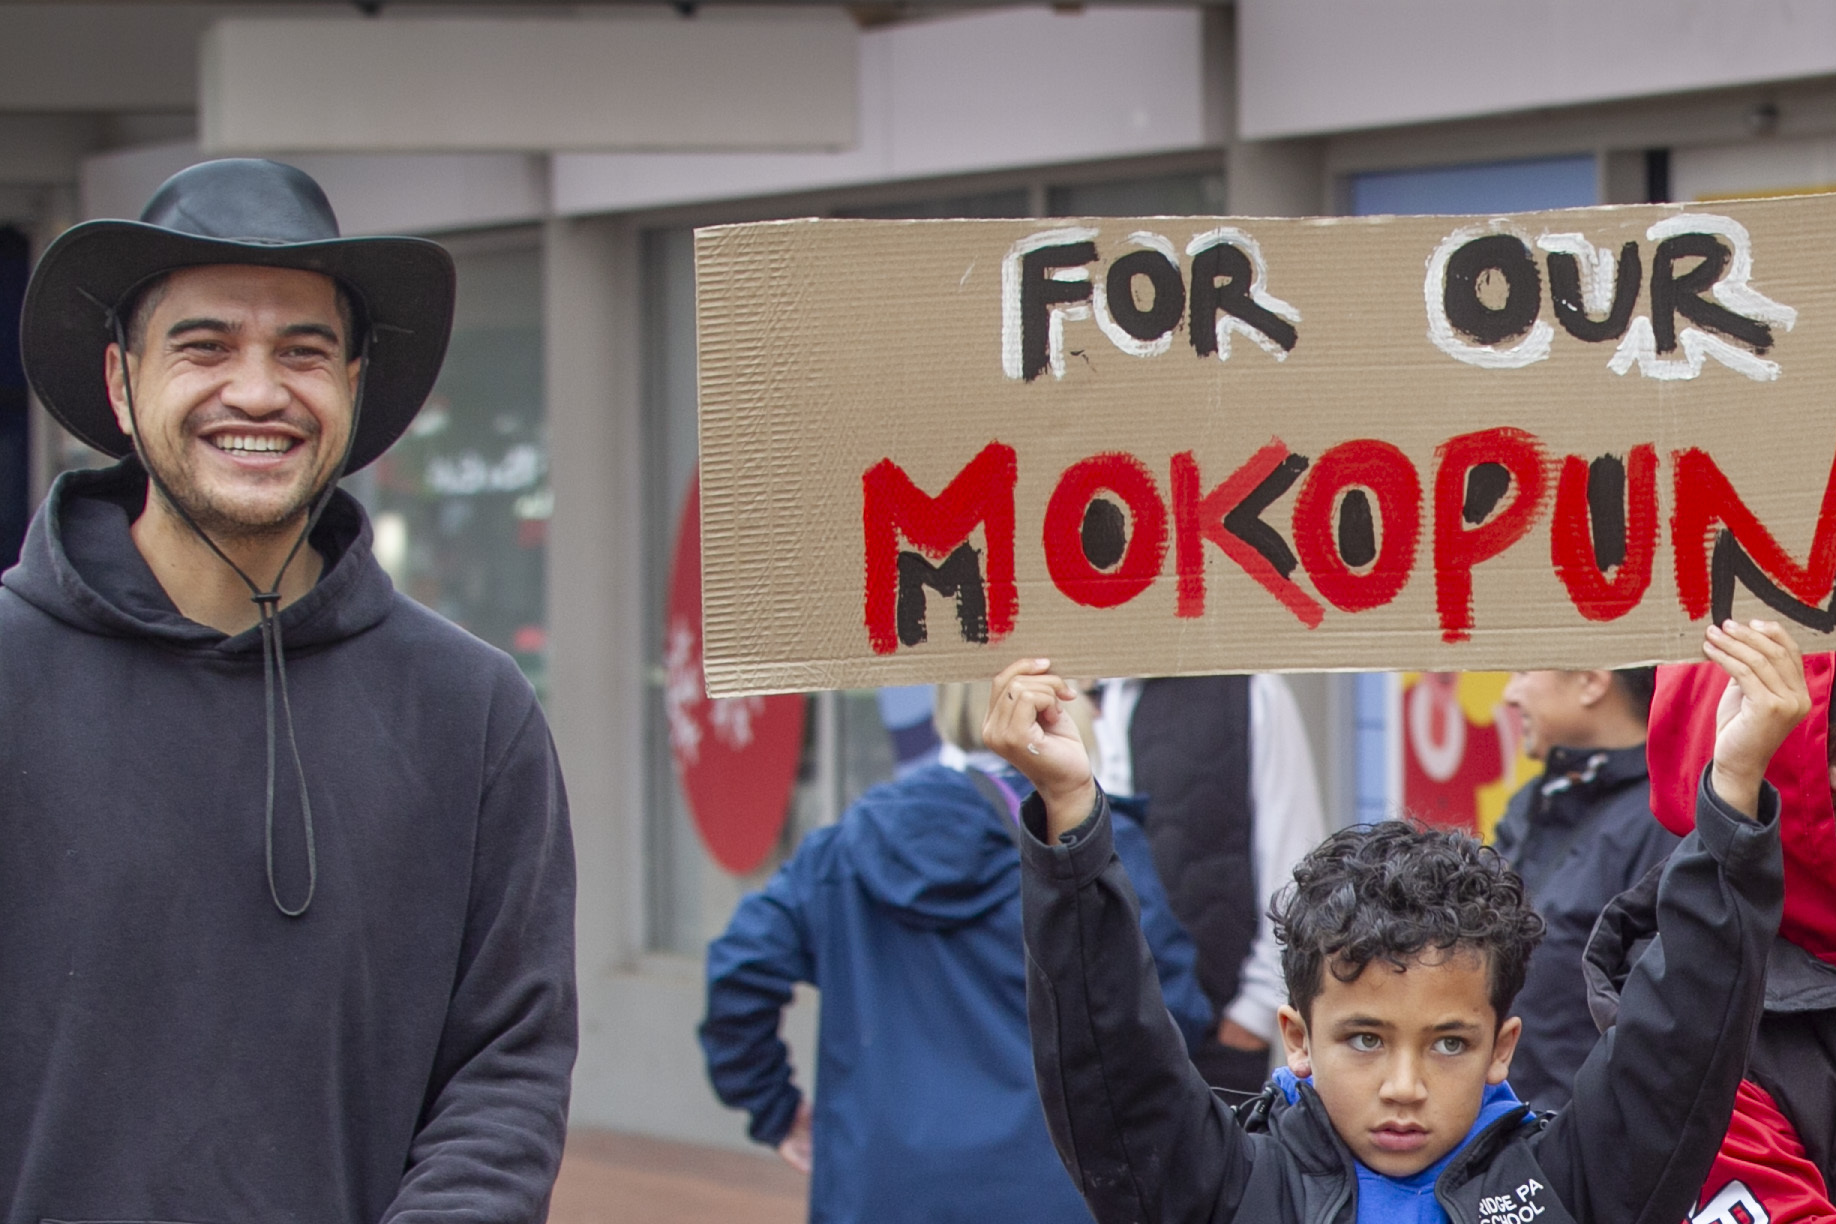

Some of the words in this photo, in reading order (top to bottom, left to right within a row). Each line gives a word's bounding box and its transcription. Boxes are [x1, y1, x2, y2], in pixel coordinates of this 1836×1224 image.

[1001, 226, 1302, 382] FOR
[1424, 213, 1797, 381] OUR
[1515, 1178, 1544, 1203] PA
